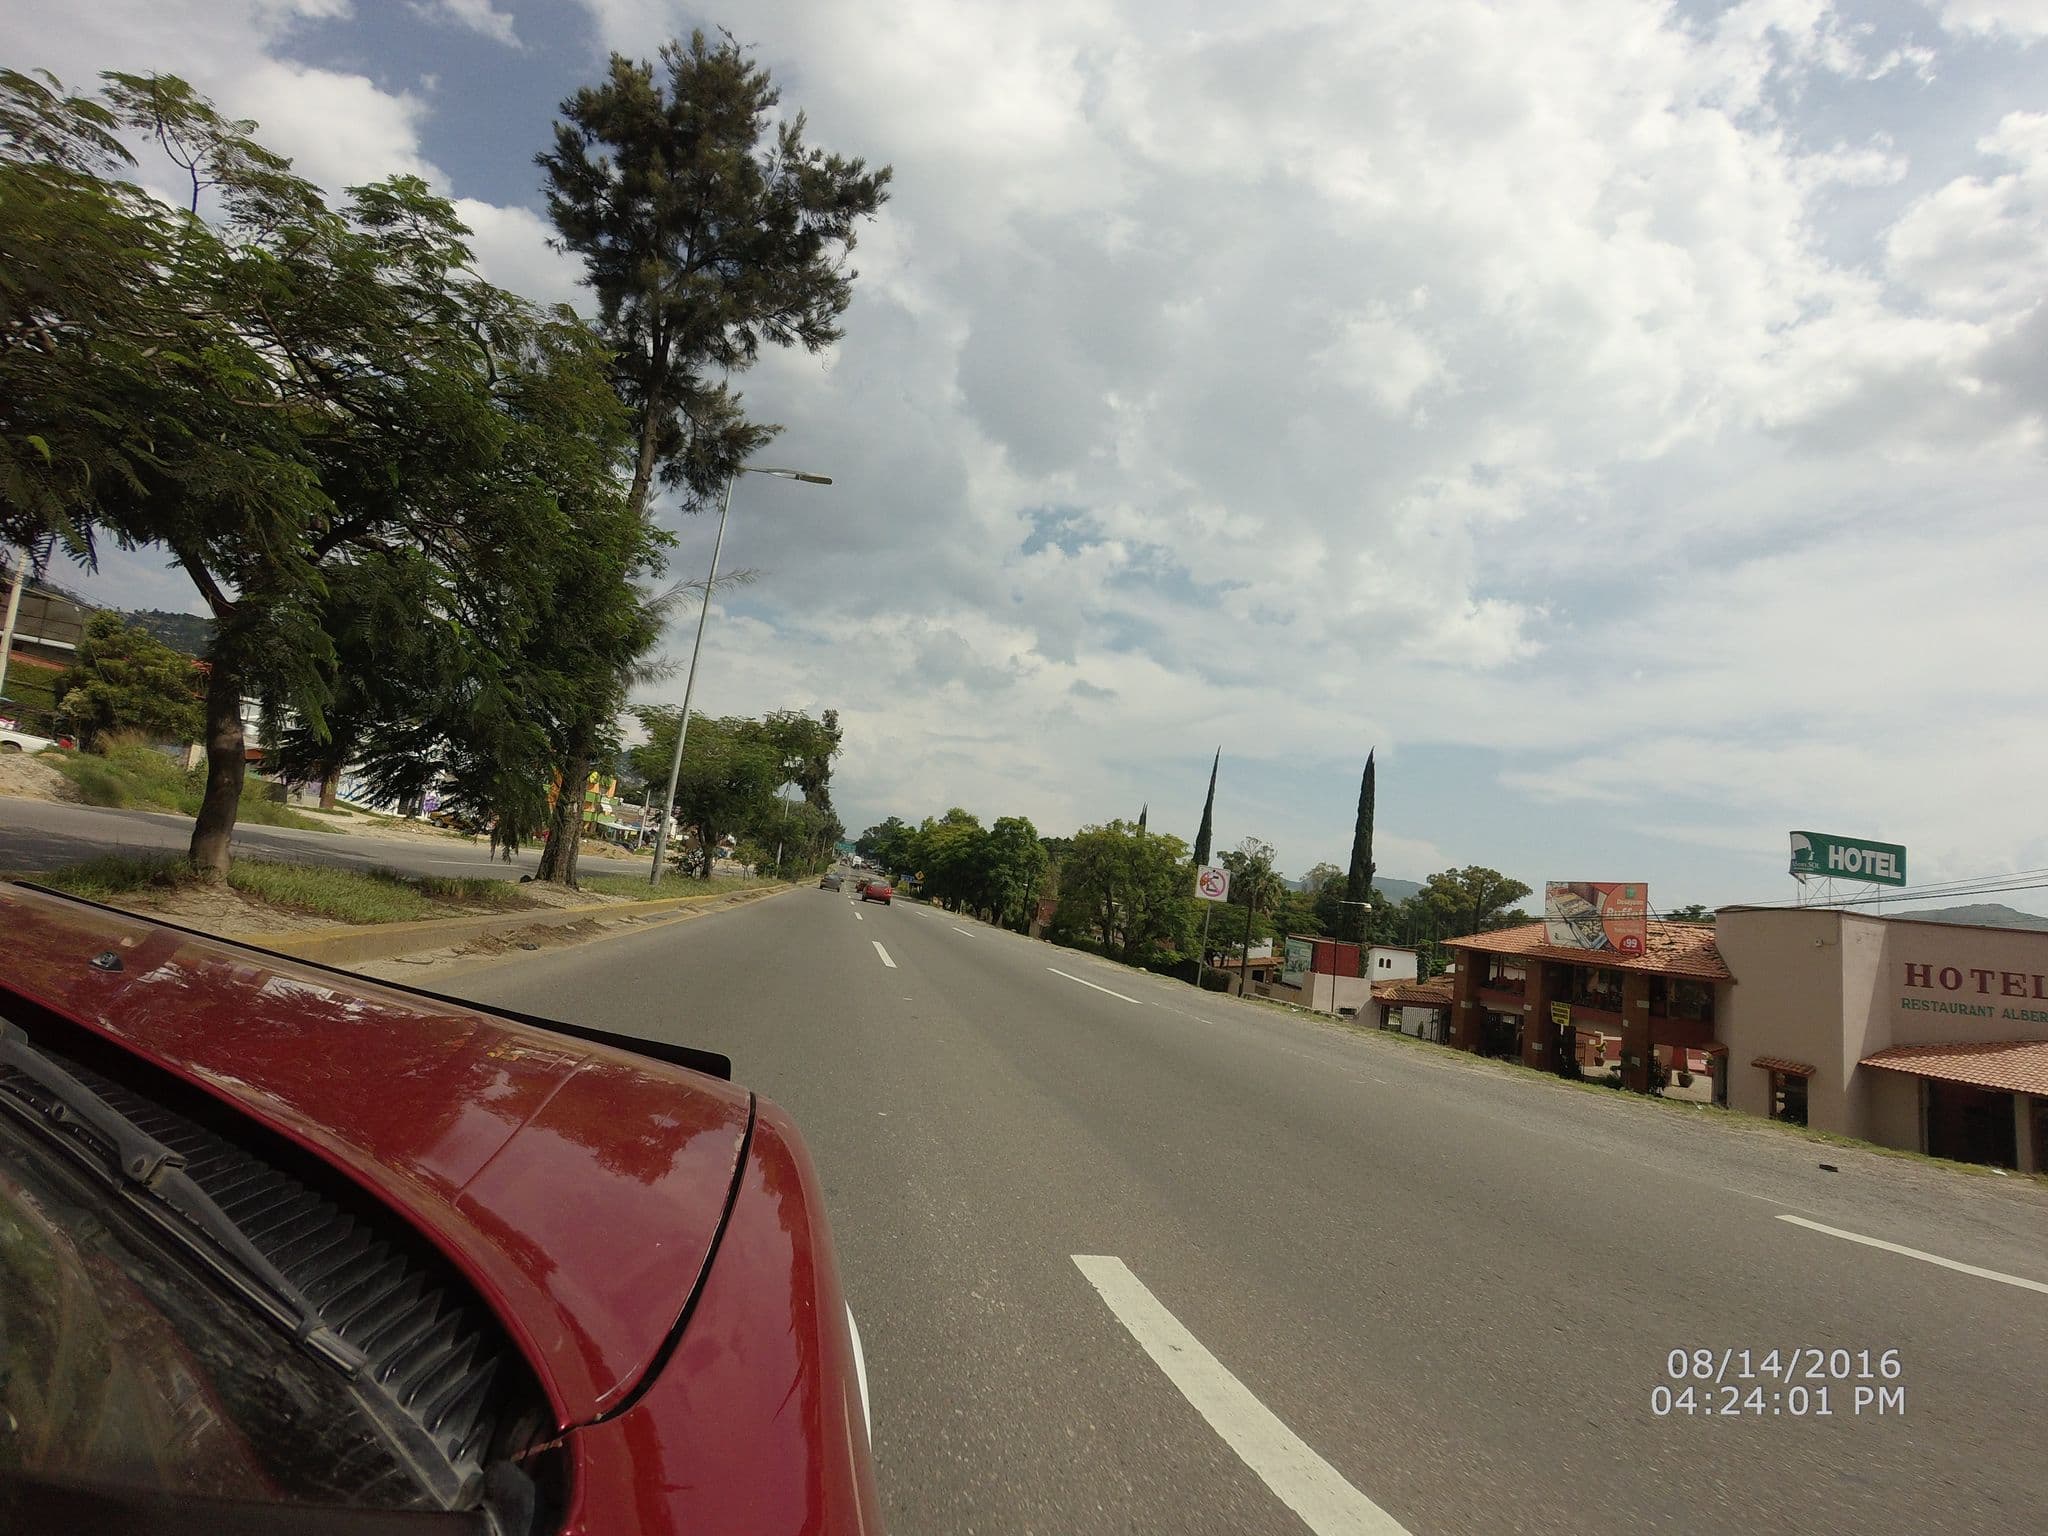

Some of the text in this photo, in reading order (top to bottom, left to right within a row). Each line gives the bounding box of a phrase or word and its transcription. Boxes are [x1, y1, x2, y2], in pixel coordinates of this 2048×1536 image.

[1828, 844, 1902, 880] HOTEL
[1606, 906, 1643, 920] Buffet
[1904, 962, 2048, 1000] HOTEL
[1901, 998, 1985, 1018] RESTAURANT
